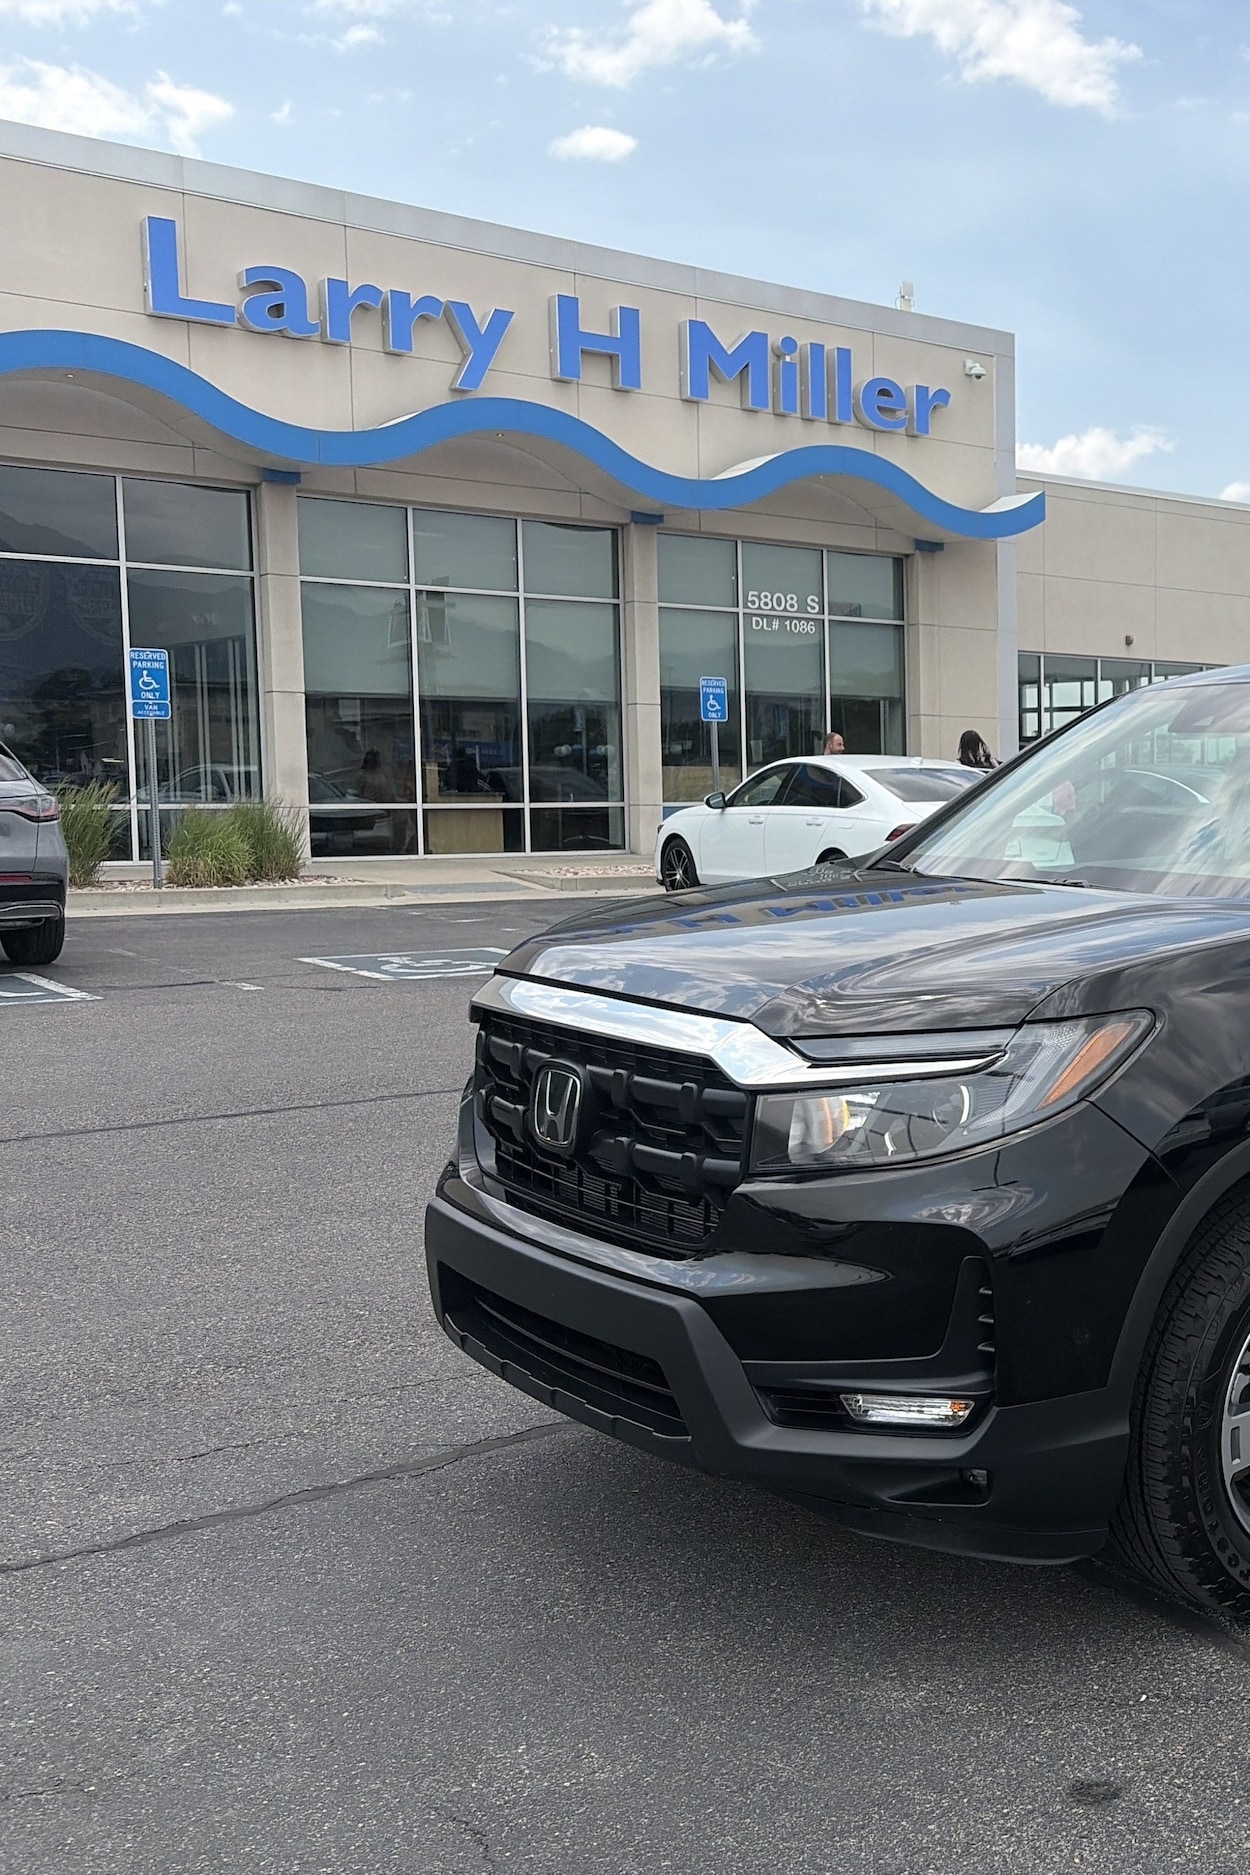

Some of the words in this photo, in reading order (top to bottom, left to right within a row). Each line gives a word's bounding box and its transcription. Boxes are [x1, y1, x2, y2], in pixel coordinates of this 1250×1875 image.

[142, 215, 514, 392] Larry
[549, 293, 643, 391] H
[680, 318, 951, 436] Miller
[747, 590, 799, 612] 5808
[806, 595, 820, 614] S
[752, 616, 779, 631] DL#
[784, 619, 816, 634] 1086
[130, 651, 166, 660] RESERVED
[132, 660, 165, 669] PARKING
[140, 691, 160, 700] ONLY
